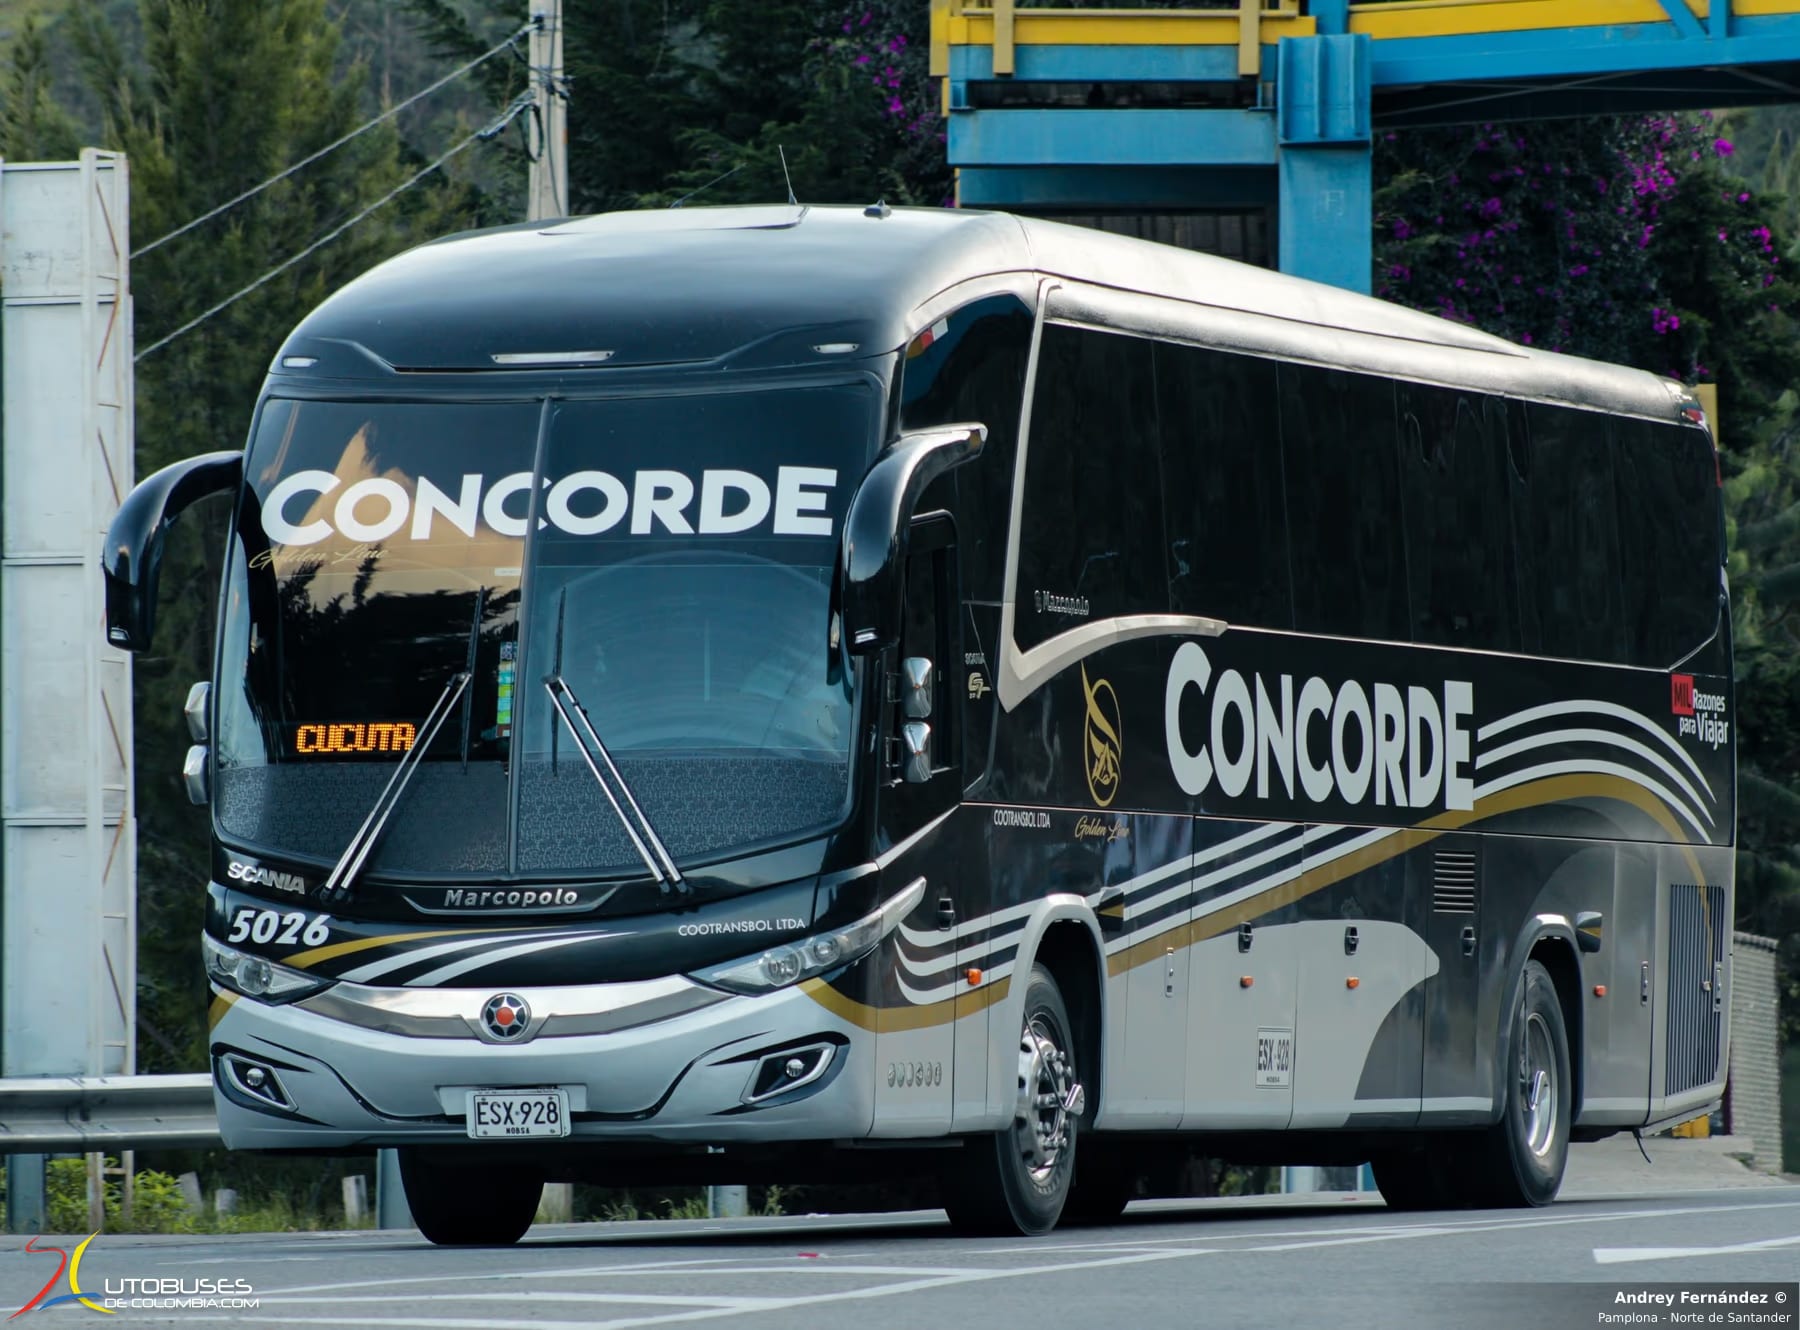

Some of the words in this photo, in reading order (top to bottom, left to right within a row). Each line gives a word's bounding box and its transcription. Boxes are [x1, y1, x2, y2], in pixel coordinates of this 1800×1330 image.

[261, 466, 838, 546] CONCORDE
[1674, 682, 1693, 708] MIL
[1692, 688, 1726, 713] Razones
[296, 723, 416, 753] CUCUTA
[1165, 641, 1474, 811] CONCORDE
[1679, 716, 1697, 737] para
[1696, 711, 1729, 751] Viajar
[994, 809, 1036, 828] COOTRANSBOL
[1037, 812, 1050, 829] LTDA
[1074, 815, 1107, 841] Golden
[227, 862, 305, 895] SCANIA
[443, 888, 578, 908] Marcopolo
[227, 909, 331, 947] 5026
[678, 920, 773, 937] COOTRANSBOL
[776, 917, 806, 930] LTDA
